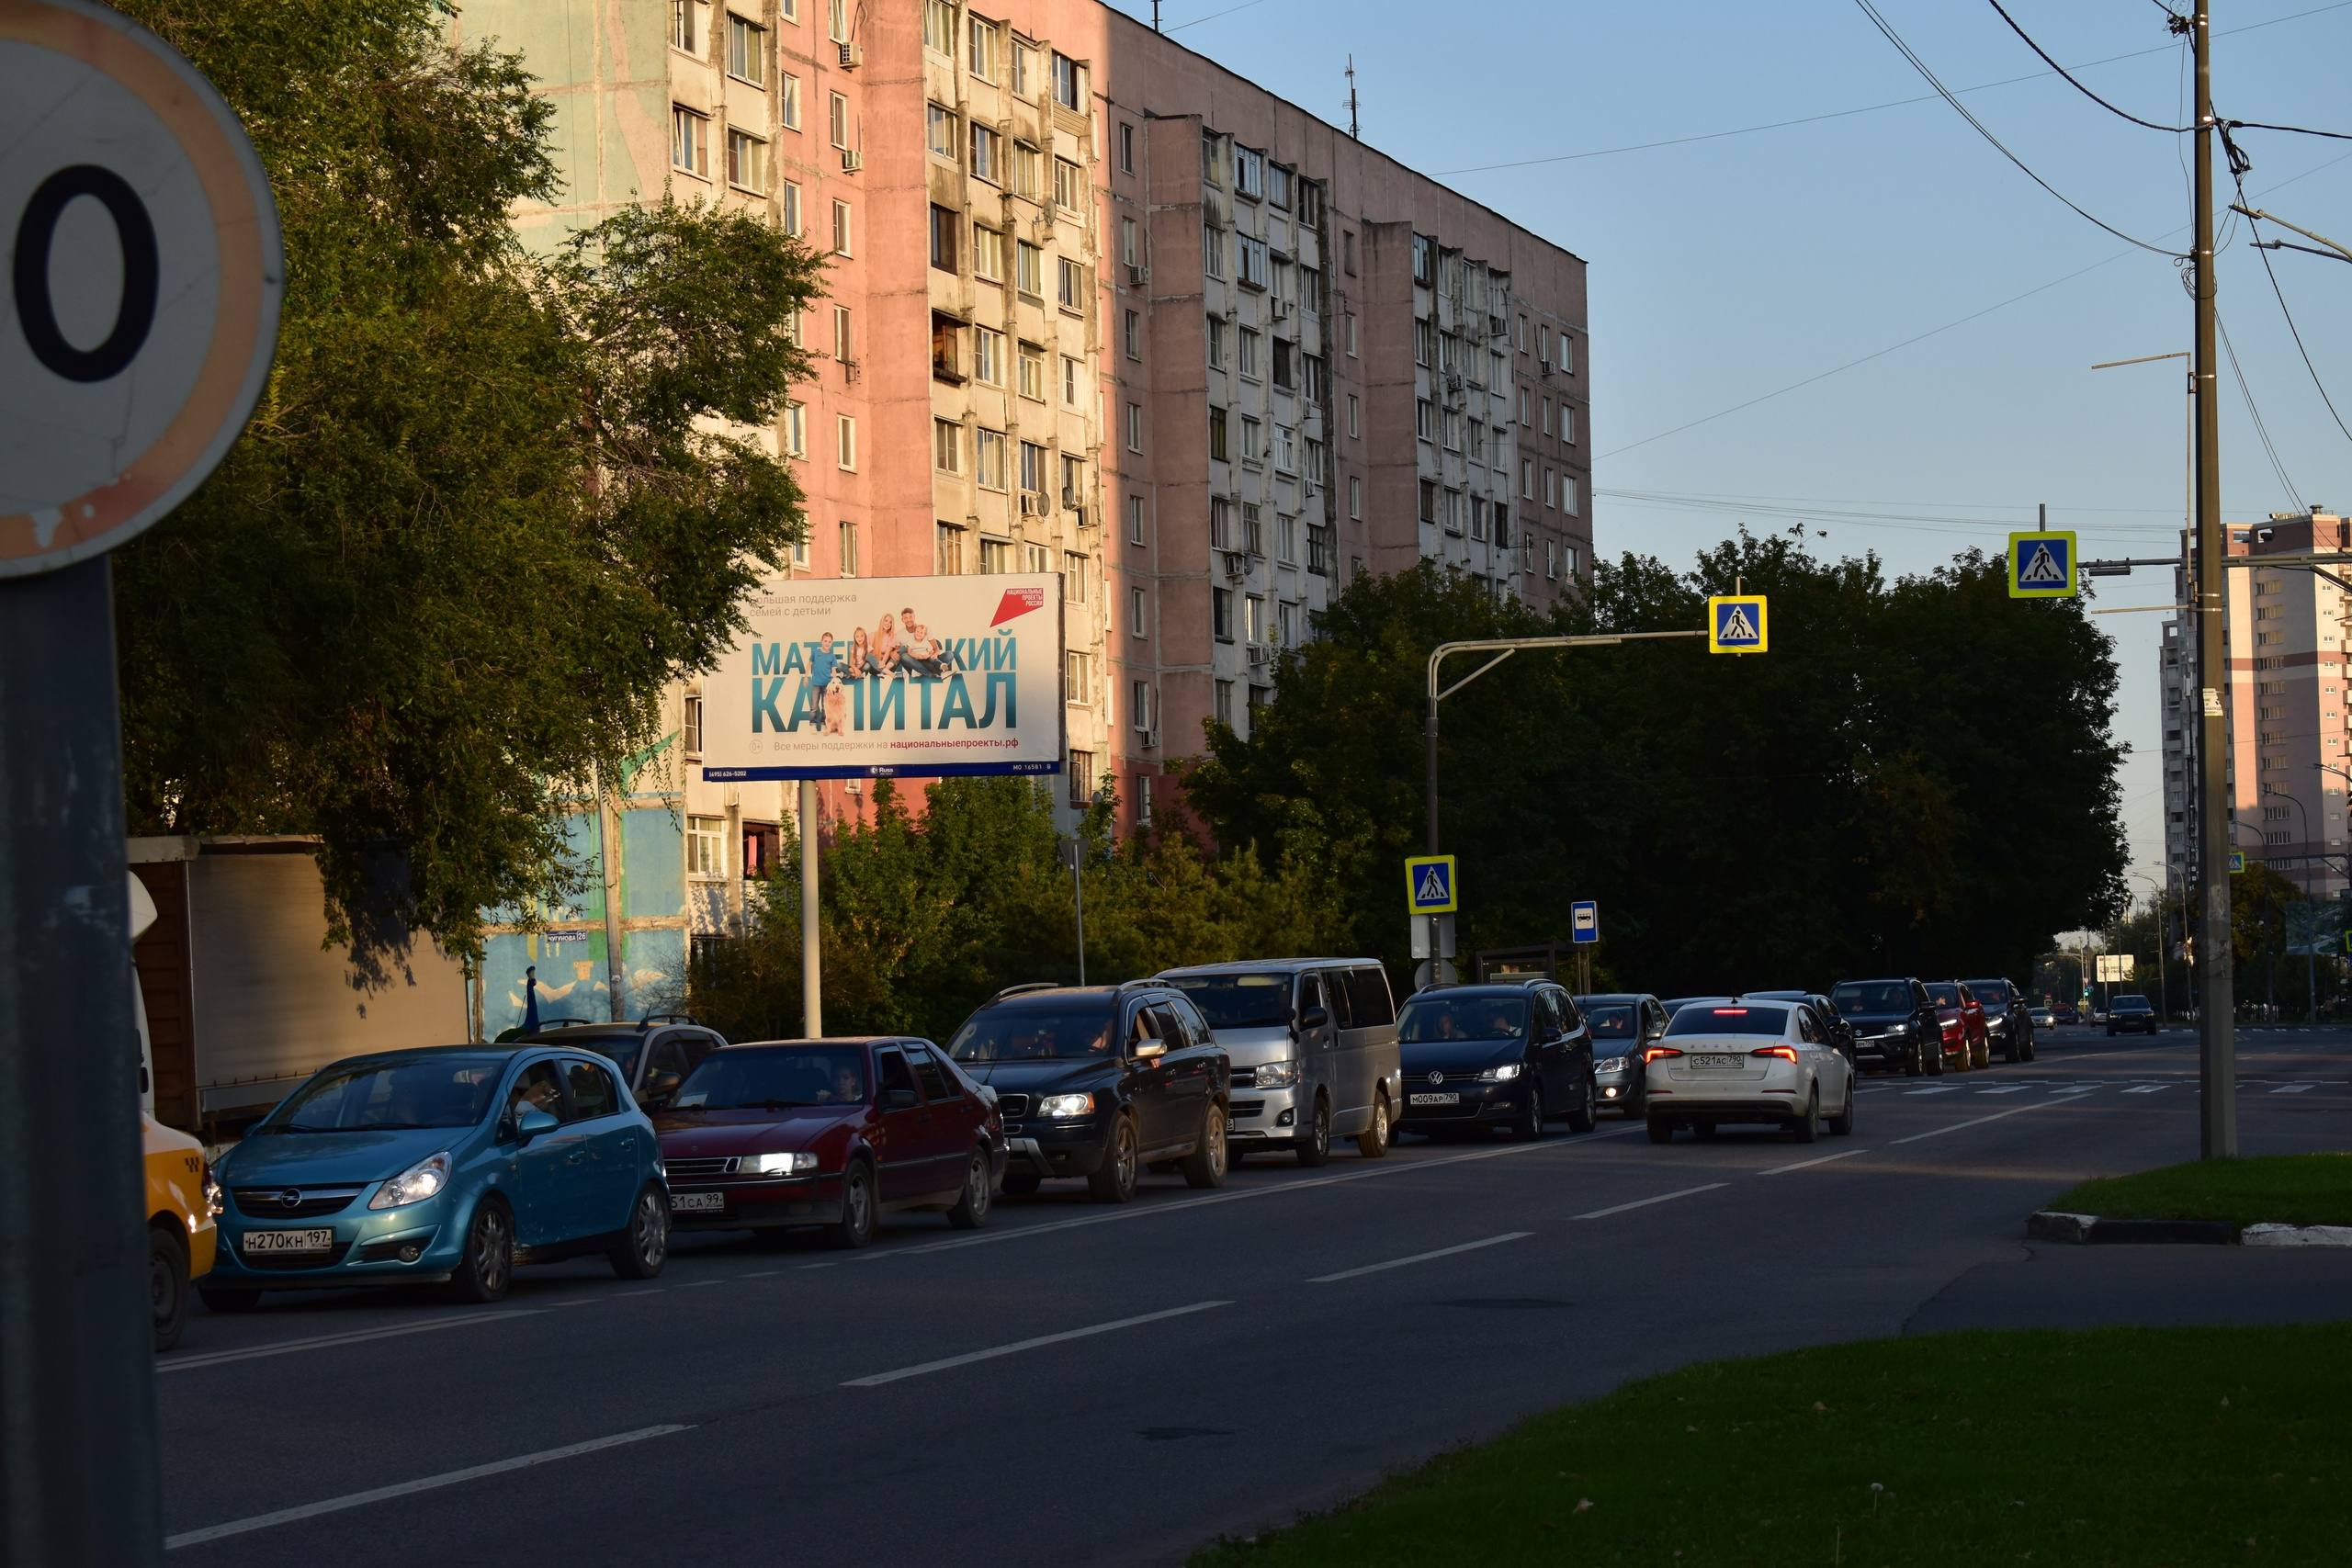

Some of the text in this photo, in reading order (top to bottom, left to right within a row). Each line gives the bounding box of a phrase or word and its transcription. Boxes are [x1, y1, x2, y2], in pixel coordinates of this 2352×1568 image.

[798, 593, 857, 604] поддержка
[750, 606, 831, 617] семей с детьми
[752, 628, 1017, 676] МАТЕКИЙ
[774, 741, 791, 751] Все
[793, 742, 820, 752] меры
[821, 739, 876, 752] поддержки
[876, 740, 888, 749] на
[890, 738, 1019, 750] национальныепроекты.рф
[578, 932, 586, 941] 26
[1728, 1055, 1741, 1063] 790
[706, 1193, 719, 1204] 99
[248, 1231, 328, 1249] Н270КН 197
